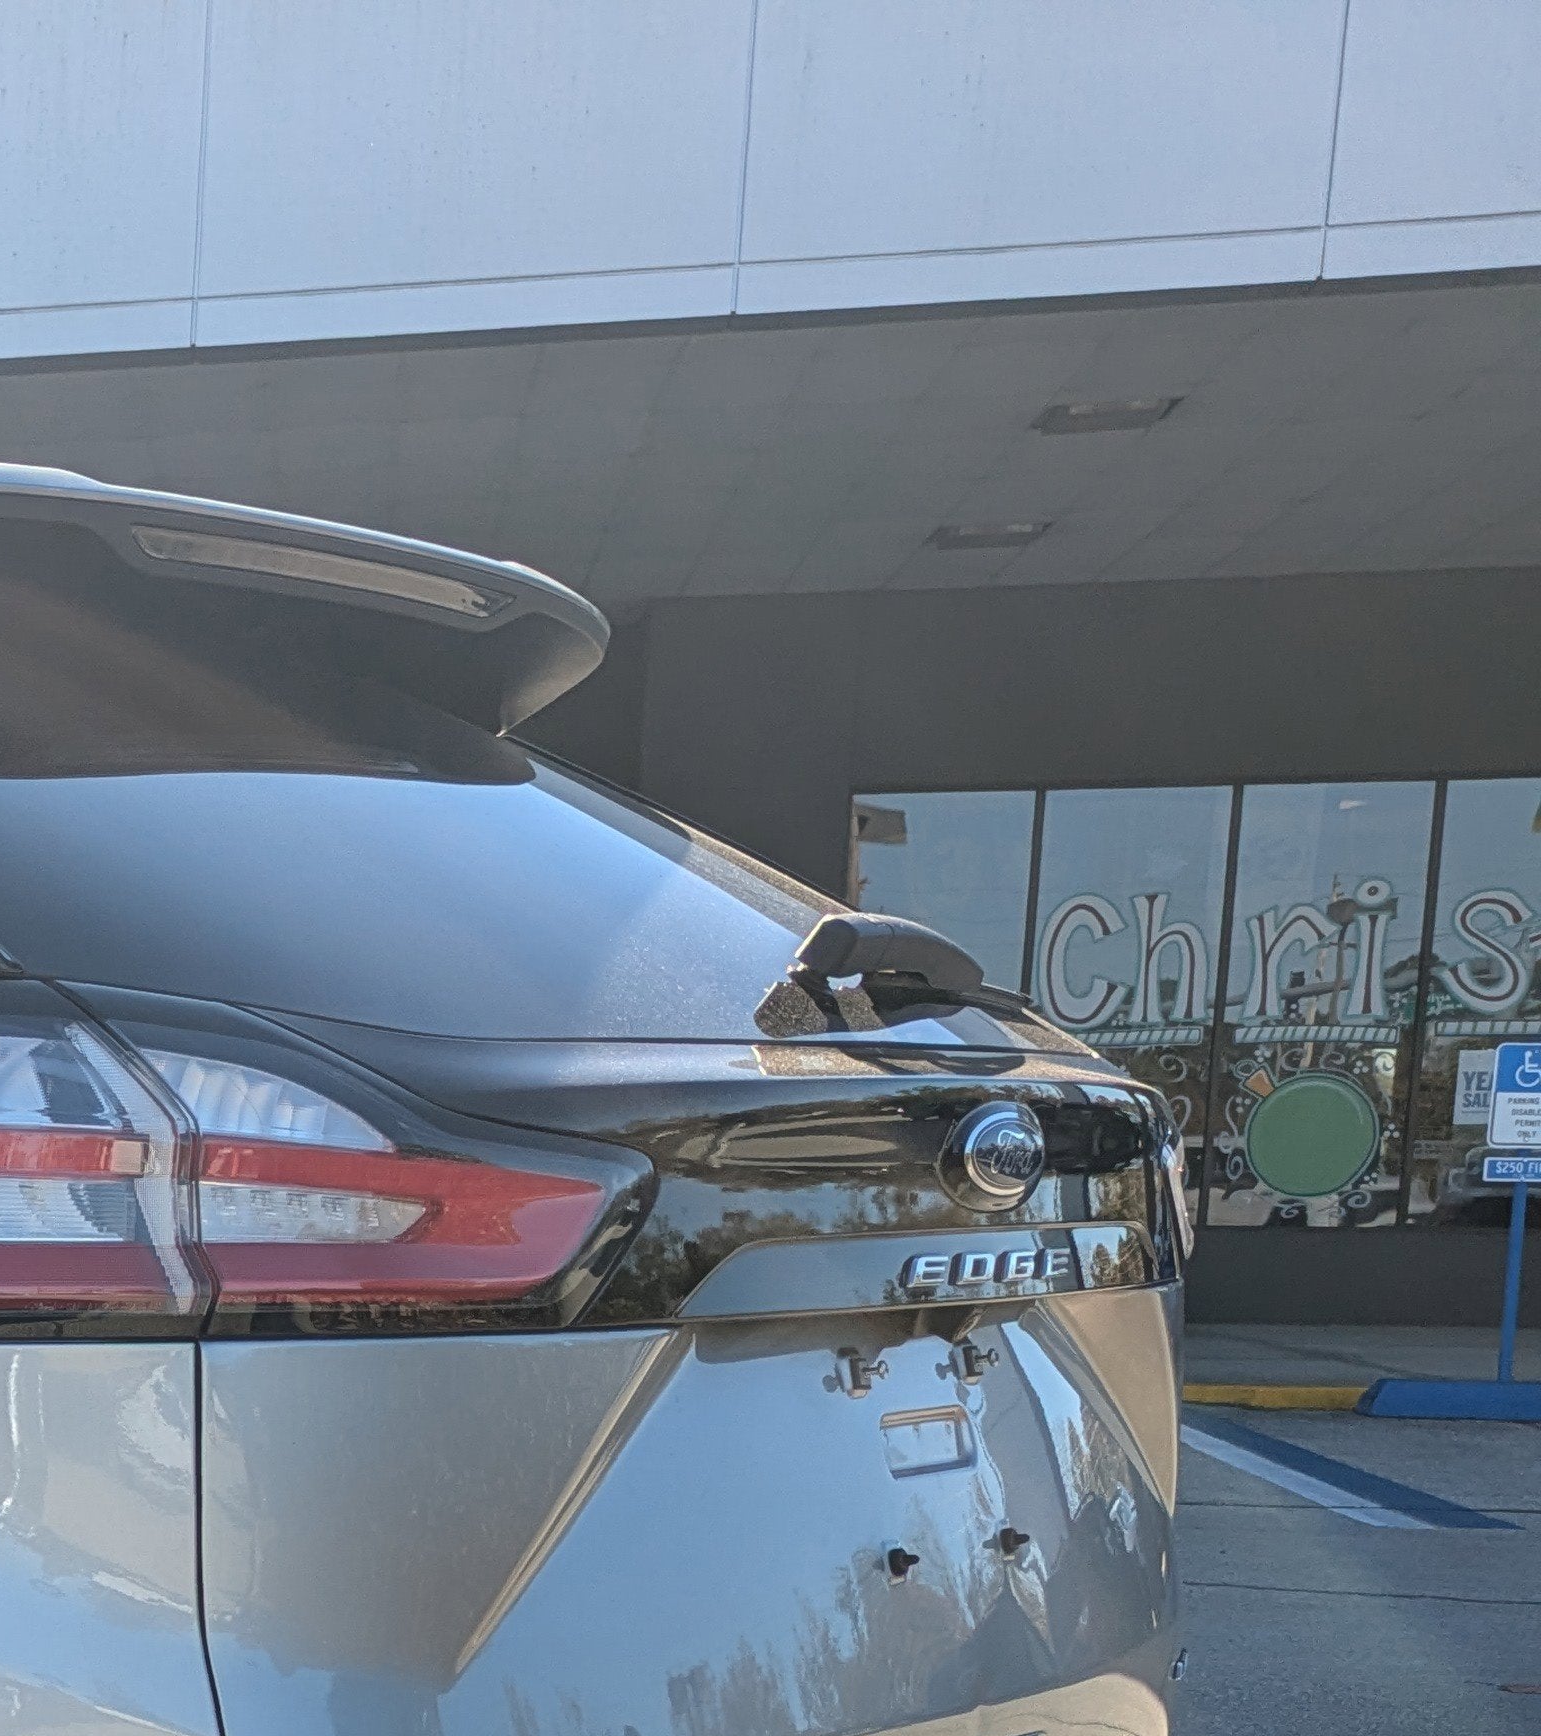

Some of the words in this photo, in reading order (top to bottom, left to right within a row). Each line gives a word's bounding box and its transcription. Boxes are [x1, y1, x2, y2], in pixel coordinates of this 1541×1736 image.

[1036, 869, 1541, 1030] Chris
[1462, 1093, 1490, 1108] SAL
[1512, 1108, 1541, 1116] DISABLE
[1517, 1130, 1536, 1138] ONLY
[1495, 1161, 1524, 1174] $250
[1528, 1162, 1541, 1173] FI
[898, 1248, 1071, 1288] EDGE
